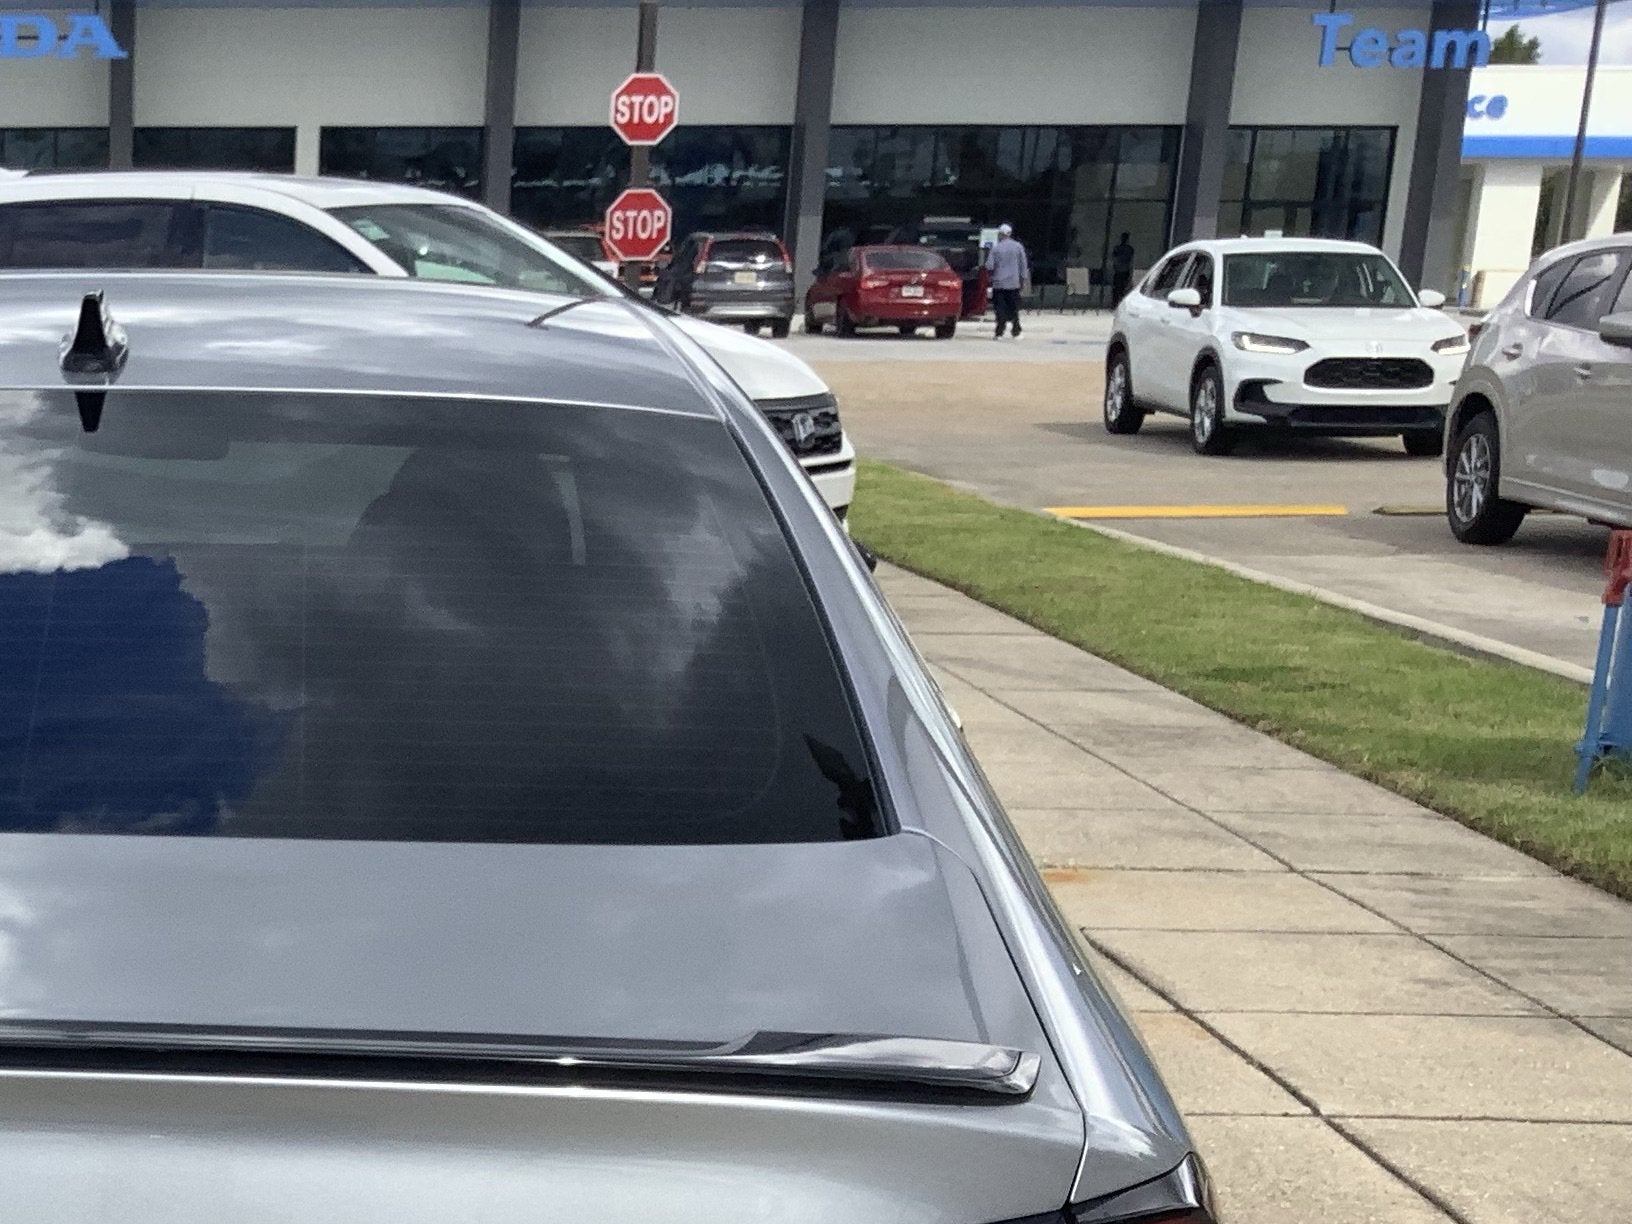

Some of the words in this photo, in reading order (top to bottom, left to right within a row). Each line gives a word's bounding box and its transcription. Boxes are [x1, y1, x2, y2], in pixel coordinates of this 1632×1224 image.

[1312, 11, 1491, 69] Team
[616, 95, 674, 125] STOP
[611, 209, 666, 240] STOP
